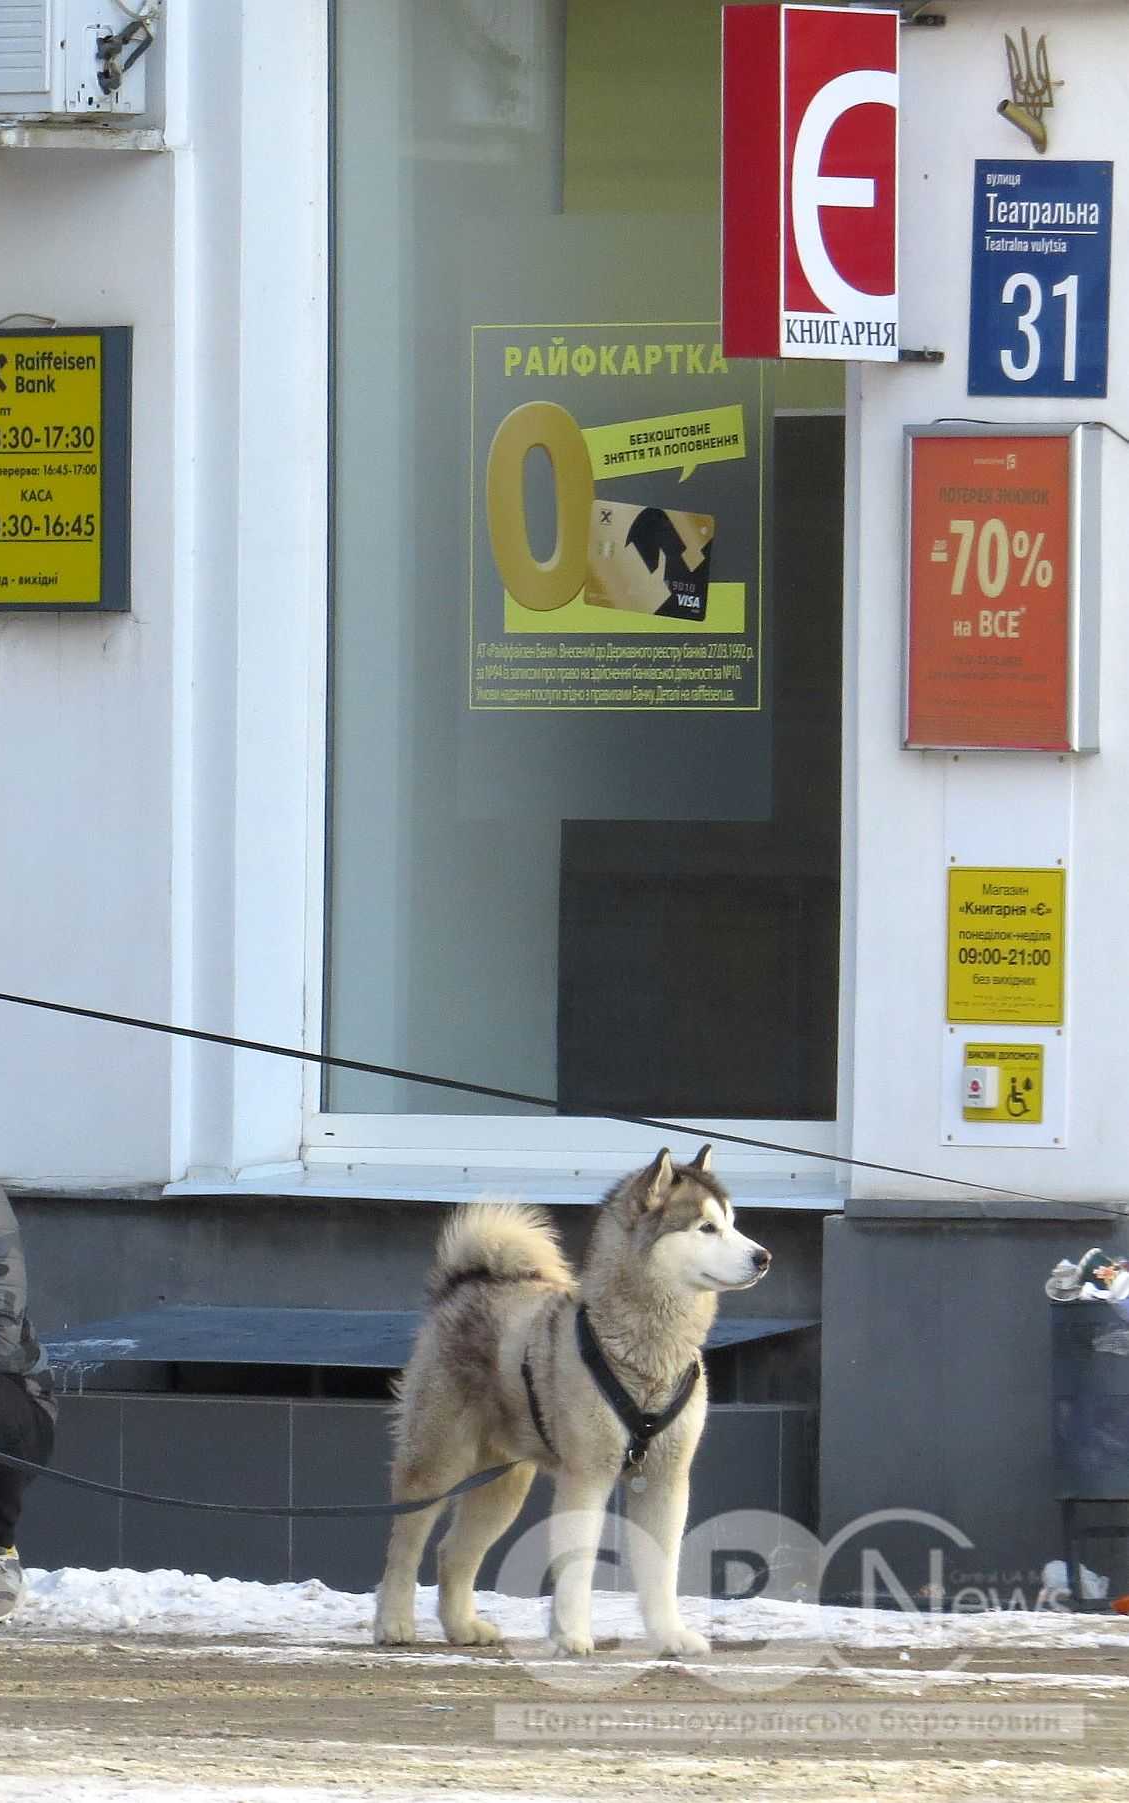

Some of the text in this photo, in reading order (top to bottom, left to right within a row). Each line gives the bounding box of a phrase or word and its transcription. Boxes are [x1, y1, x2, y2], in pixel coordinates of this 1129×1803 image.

[986, 173, 1021, 188] вулиця
[986, 193, 1099, 230] Театральна
[984, 236, 1067, 254] Teatralna vulytsia
[785, 319, 897, 347] КНИГАРНЯ
[999, 272, 1080, 382] 31
[15, 352, 96, 371] Raiffeisen
[504, 337, 729, 377] РАЙФКАРТКА
[15, 375, 56, 393] Bank
[0, 406, 11, 417] пт
[629, 423, 711, 446] БЕЗКОШТОВНЕ
[603, 434, 739, 466] ЗНЯТТЯ ТА ПОПОВНЕННЯ
[43, 464, 98, 476] 16:45-17:00
[21, 489, 53, 502] КАСА
[931, 518, 1054, 598] -70%
[19, 572, 58, 585] вихідні
[676, 594, 700, 609] VISA
[953, 620, 972, 636] на
[982, 883, 1029, 897] Магазин
[959, 901, 1026, 917] «Книгарня
[958, 929, 1051, 942] понеділок-неділя
[958, 947, 1051, 967] 09:00-21:00
[973, 973, 990, 985] без
